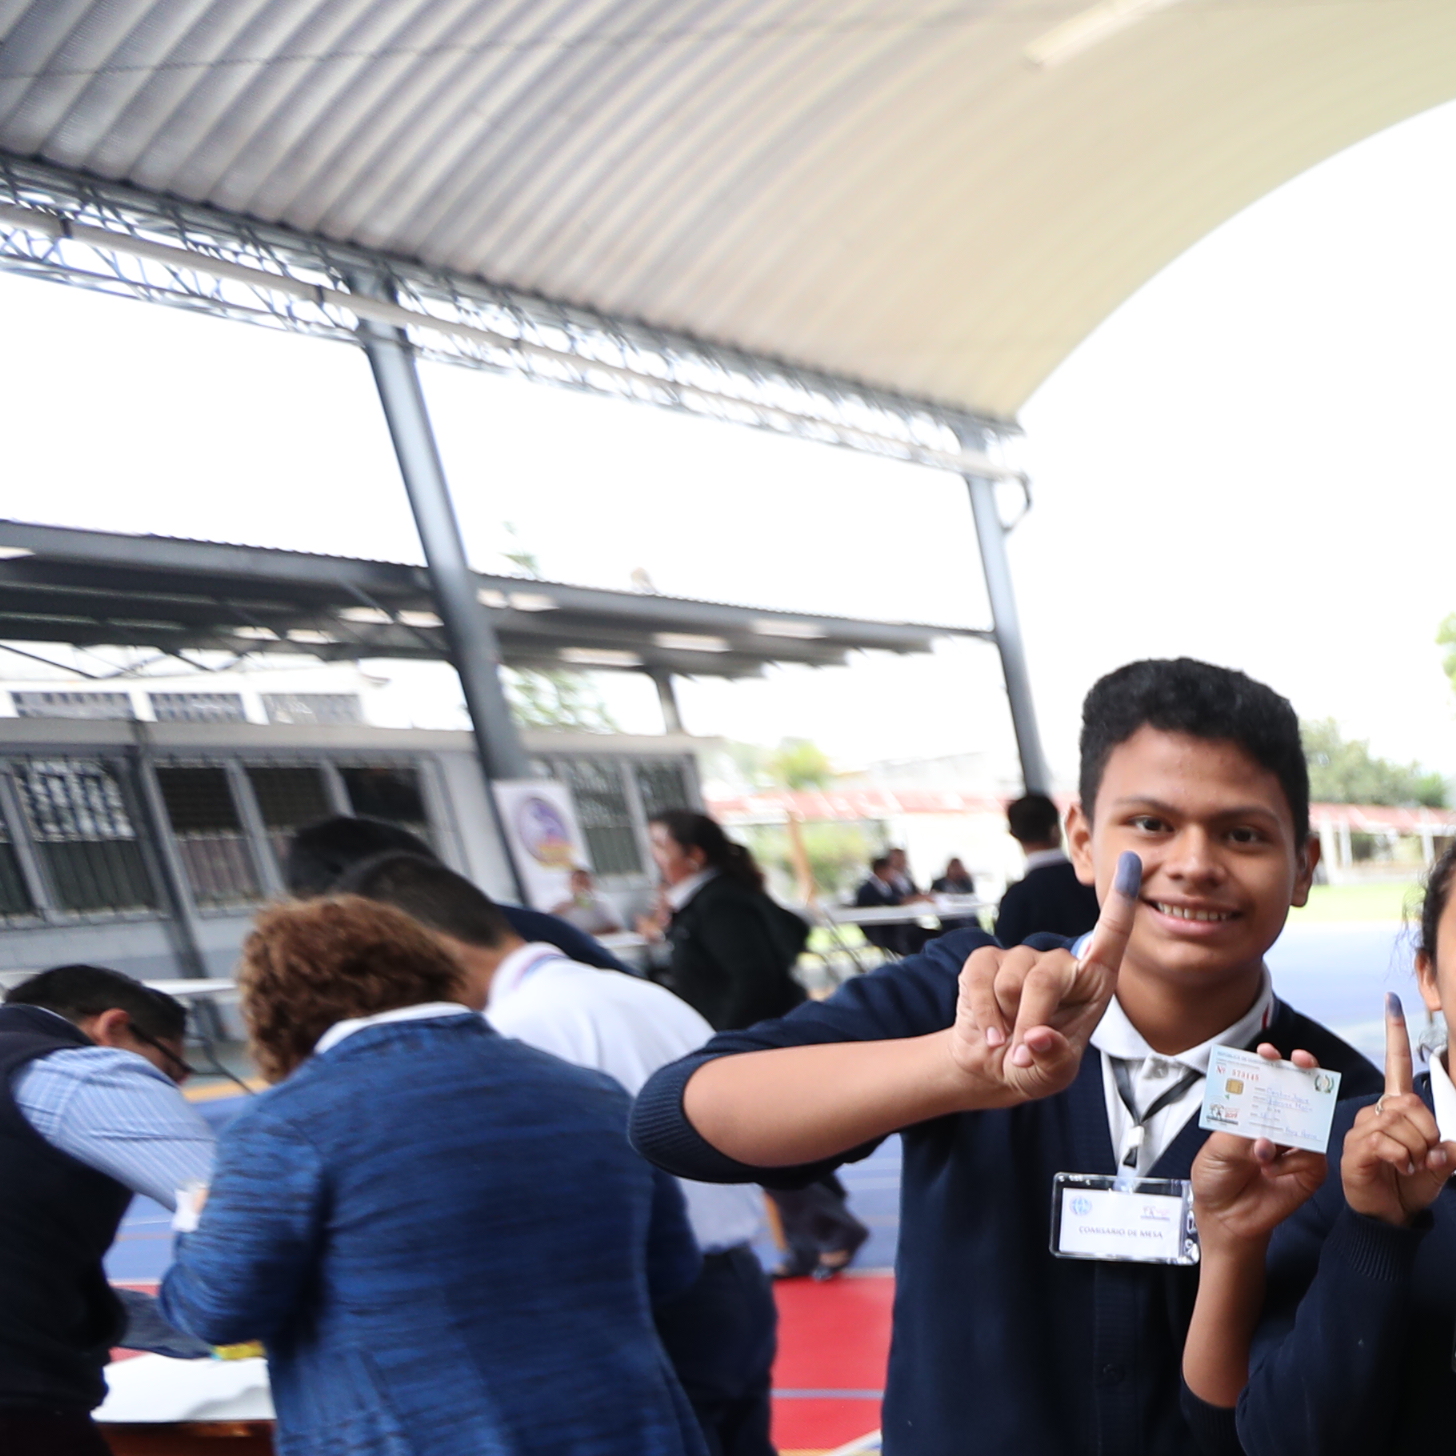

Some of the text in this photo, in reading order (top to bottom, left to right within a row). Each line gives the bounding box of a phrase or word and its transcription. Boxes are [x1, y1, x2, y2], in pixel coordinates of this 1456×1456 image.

[1079, 1225, 1163, 1239] COMISARIO DE MESA
